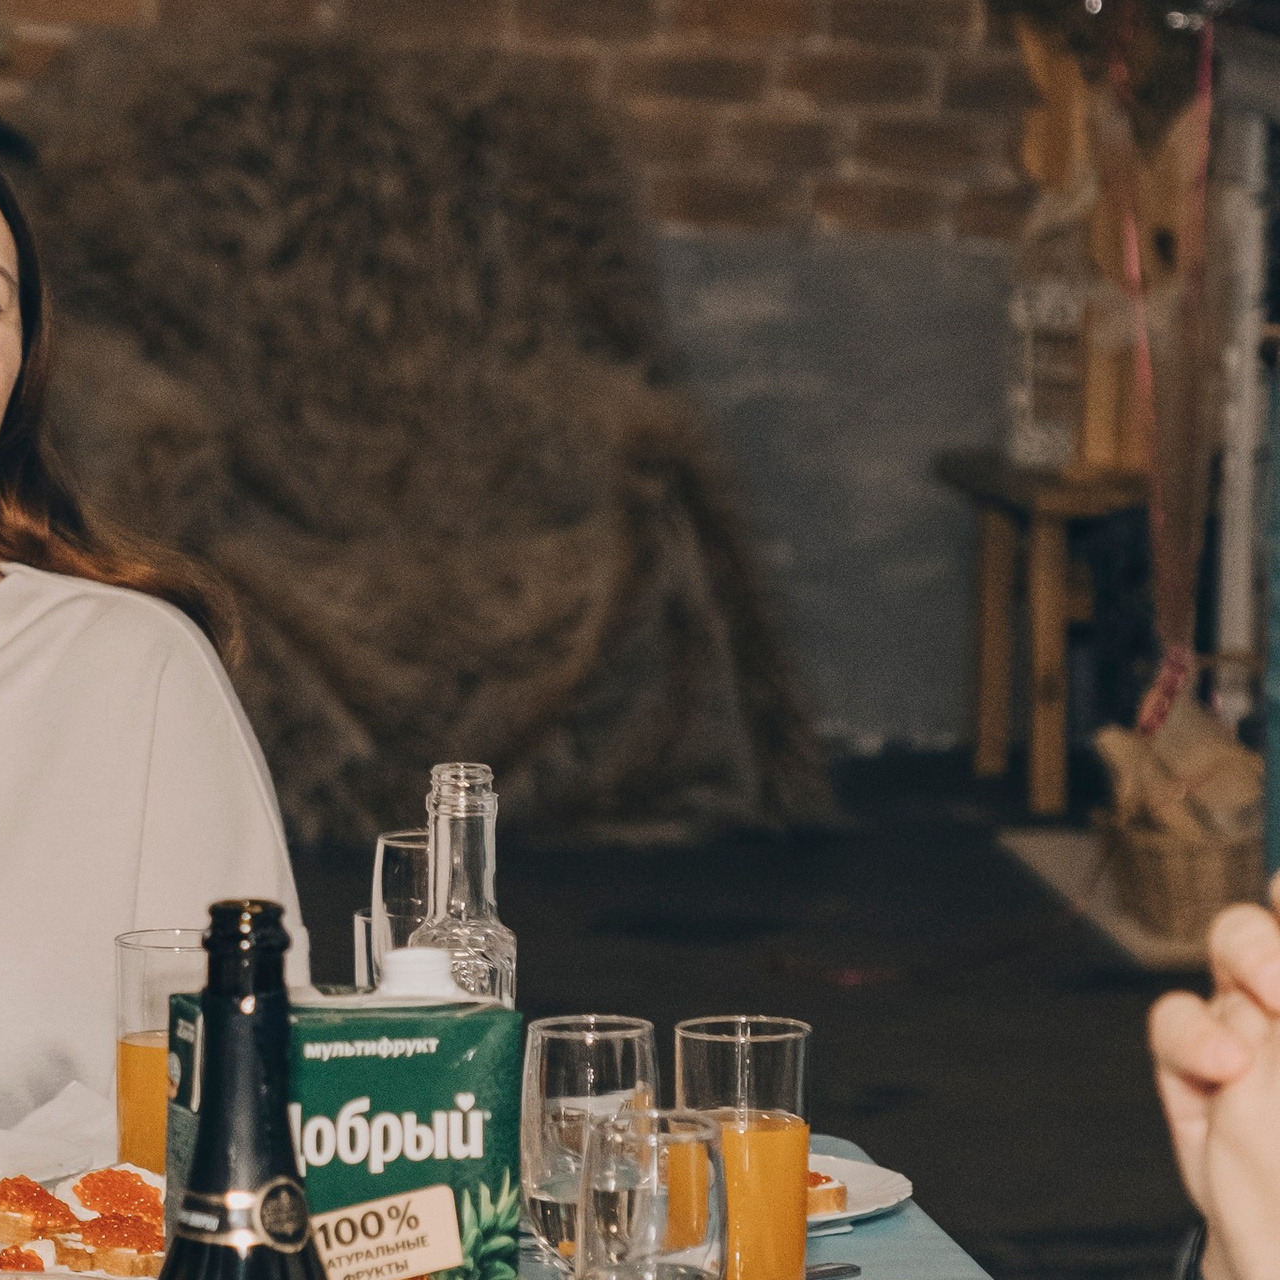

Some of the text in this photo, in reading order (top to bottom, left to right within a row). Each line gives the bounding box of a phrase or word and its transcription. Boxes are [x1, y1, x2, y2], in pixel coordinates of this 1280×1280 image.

[303, 1036, 439, 1061] мультифрукт
[318, 1200, 420, 1251] 100%
[325, 1235, 429, 1271] АТУРАЛЬНЫЕ
